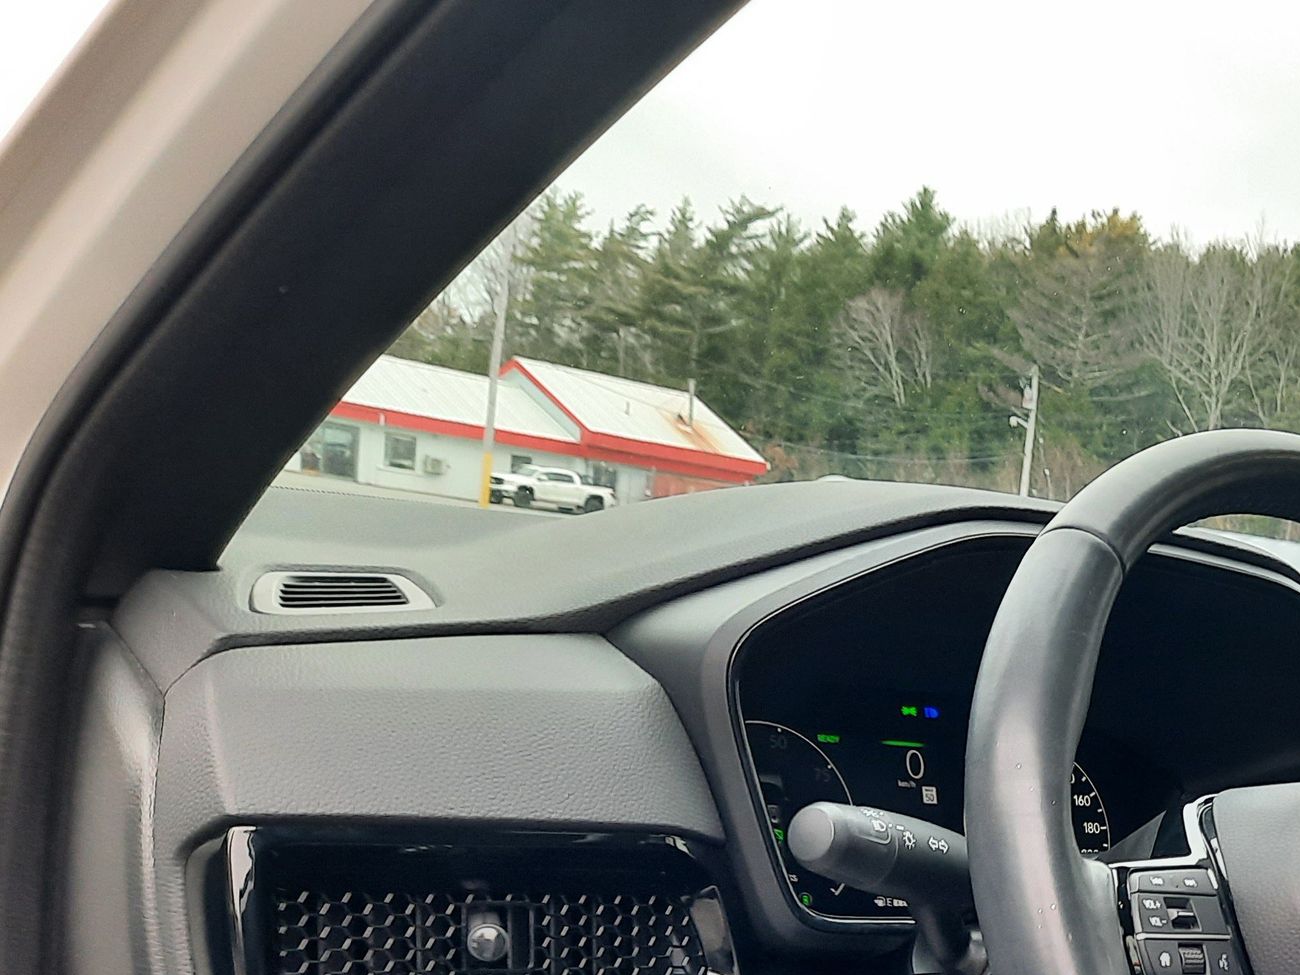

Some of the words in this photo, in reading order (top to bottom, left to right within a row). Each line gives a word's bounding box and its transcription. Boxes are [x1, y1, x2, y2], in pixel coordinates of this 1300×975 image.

[906, 749, 925, 780] 0
[1073, 794, 1091, 807] 160
[1083, 821, 1101, 835] 180
[1142, 898, 1162, 910] VOL+
